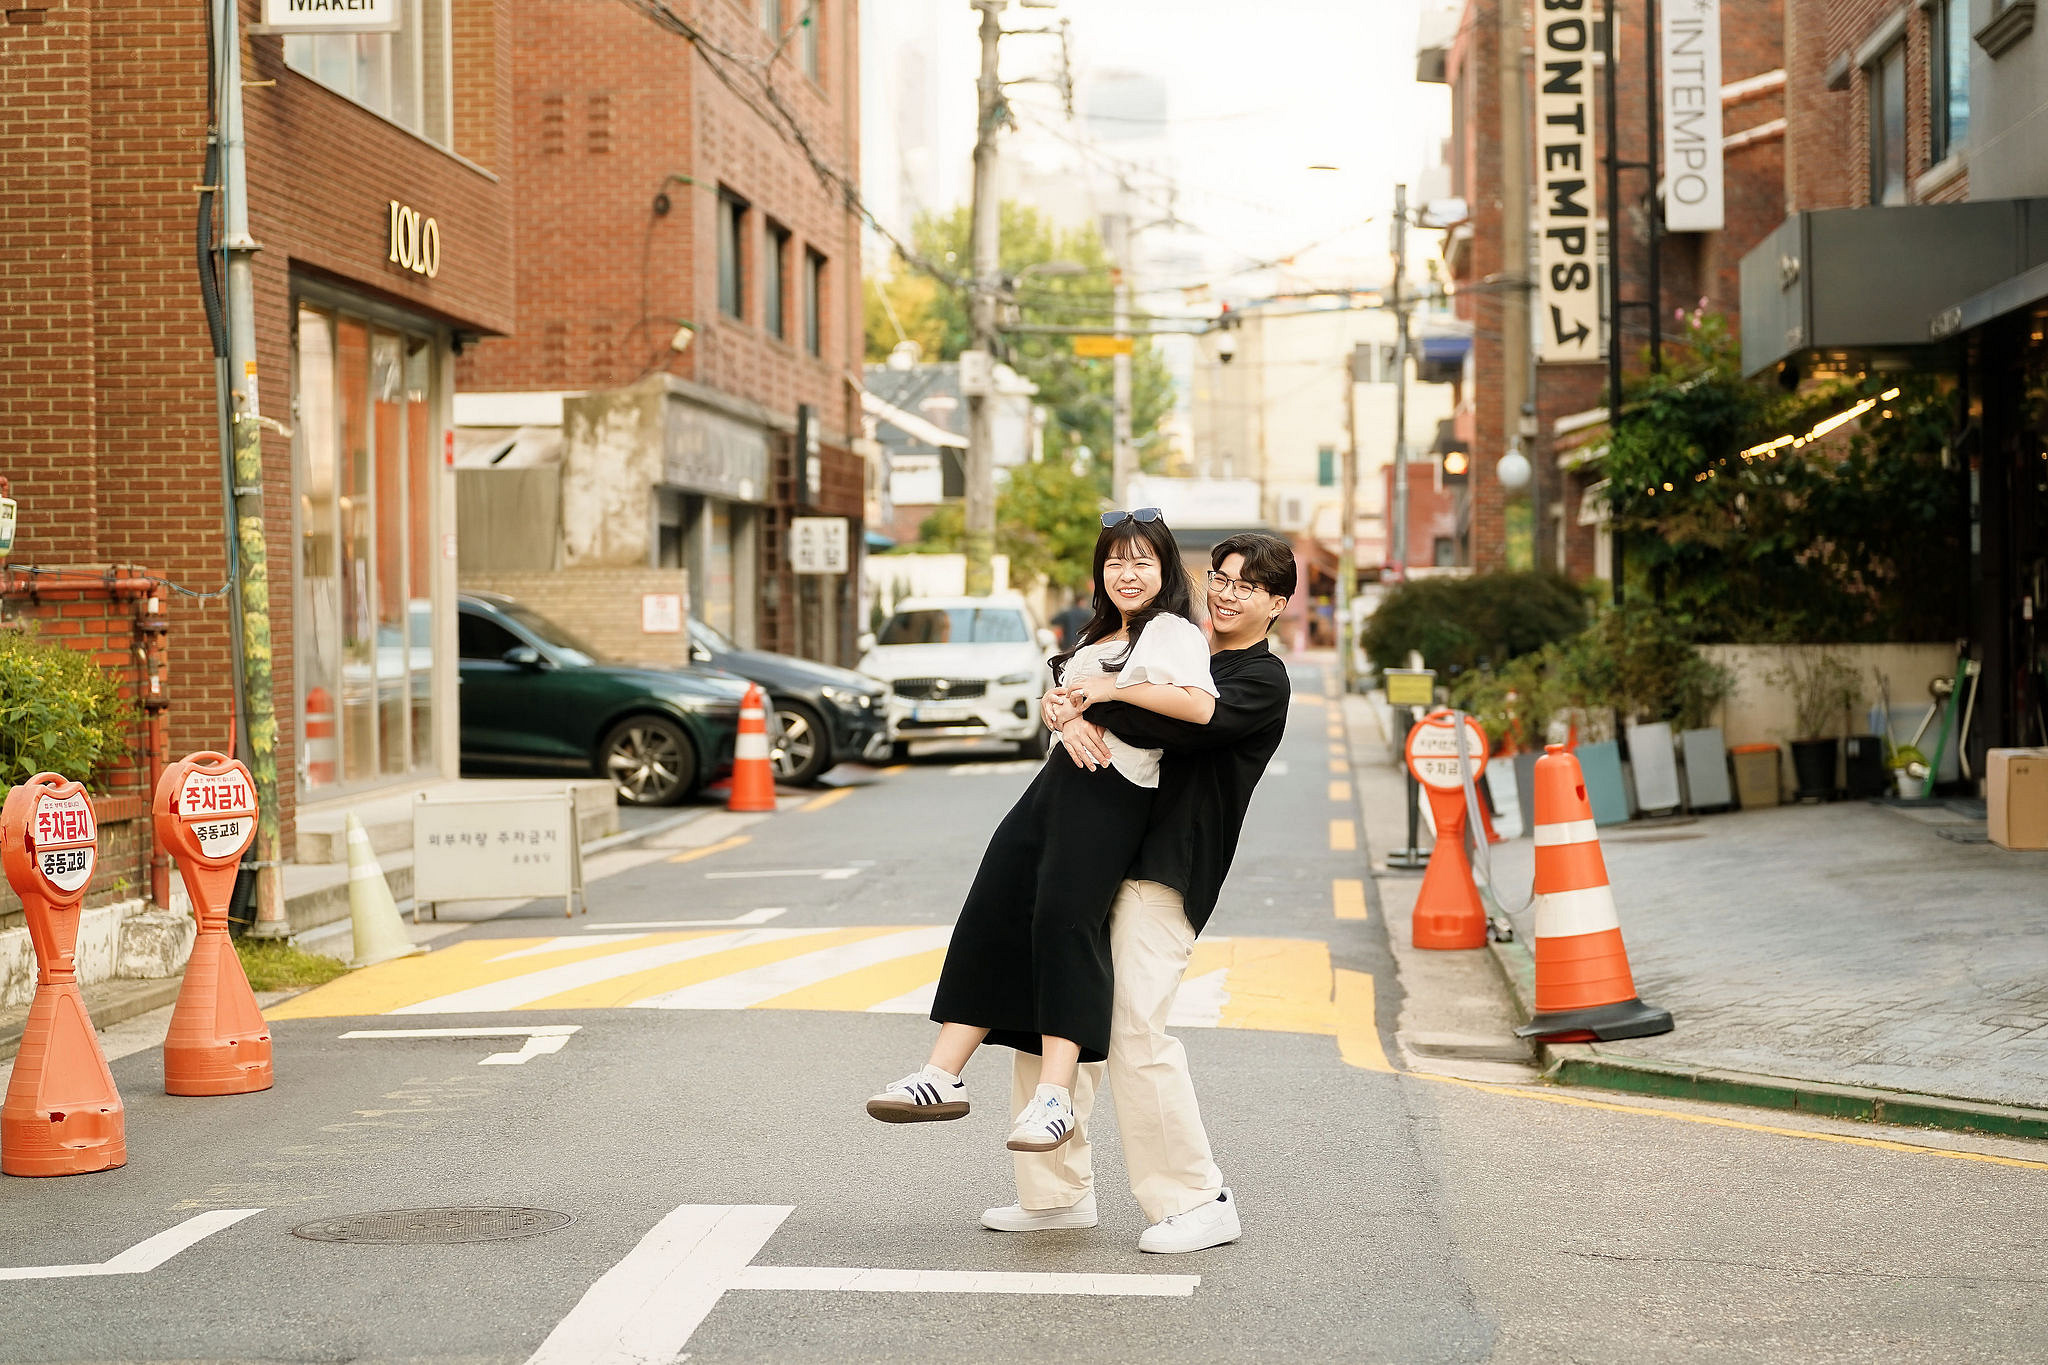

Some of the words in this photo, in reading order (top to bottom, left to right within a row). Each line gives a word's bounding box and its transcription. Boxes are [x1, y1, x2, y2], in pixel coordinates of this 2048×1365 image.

[1671, 19, 1708, 205] INTEMPO
[389, 200, 440, 278] IOLO
[186, 784, 246, 811] 주차금지
[38, 810, 88, 841] 주차금지
[197, 822, 239, 841] 중동교회
[428, 831, 488, 847] 외부차량
[498, 829, 556, 845] 주차금지
[44, 851, 86, 875] 중동교회
